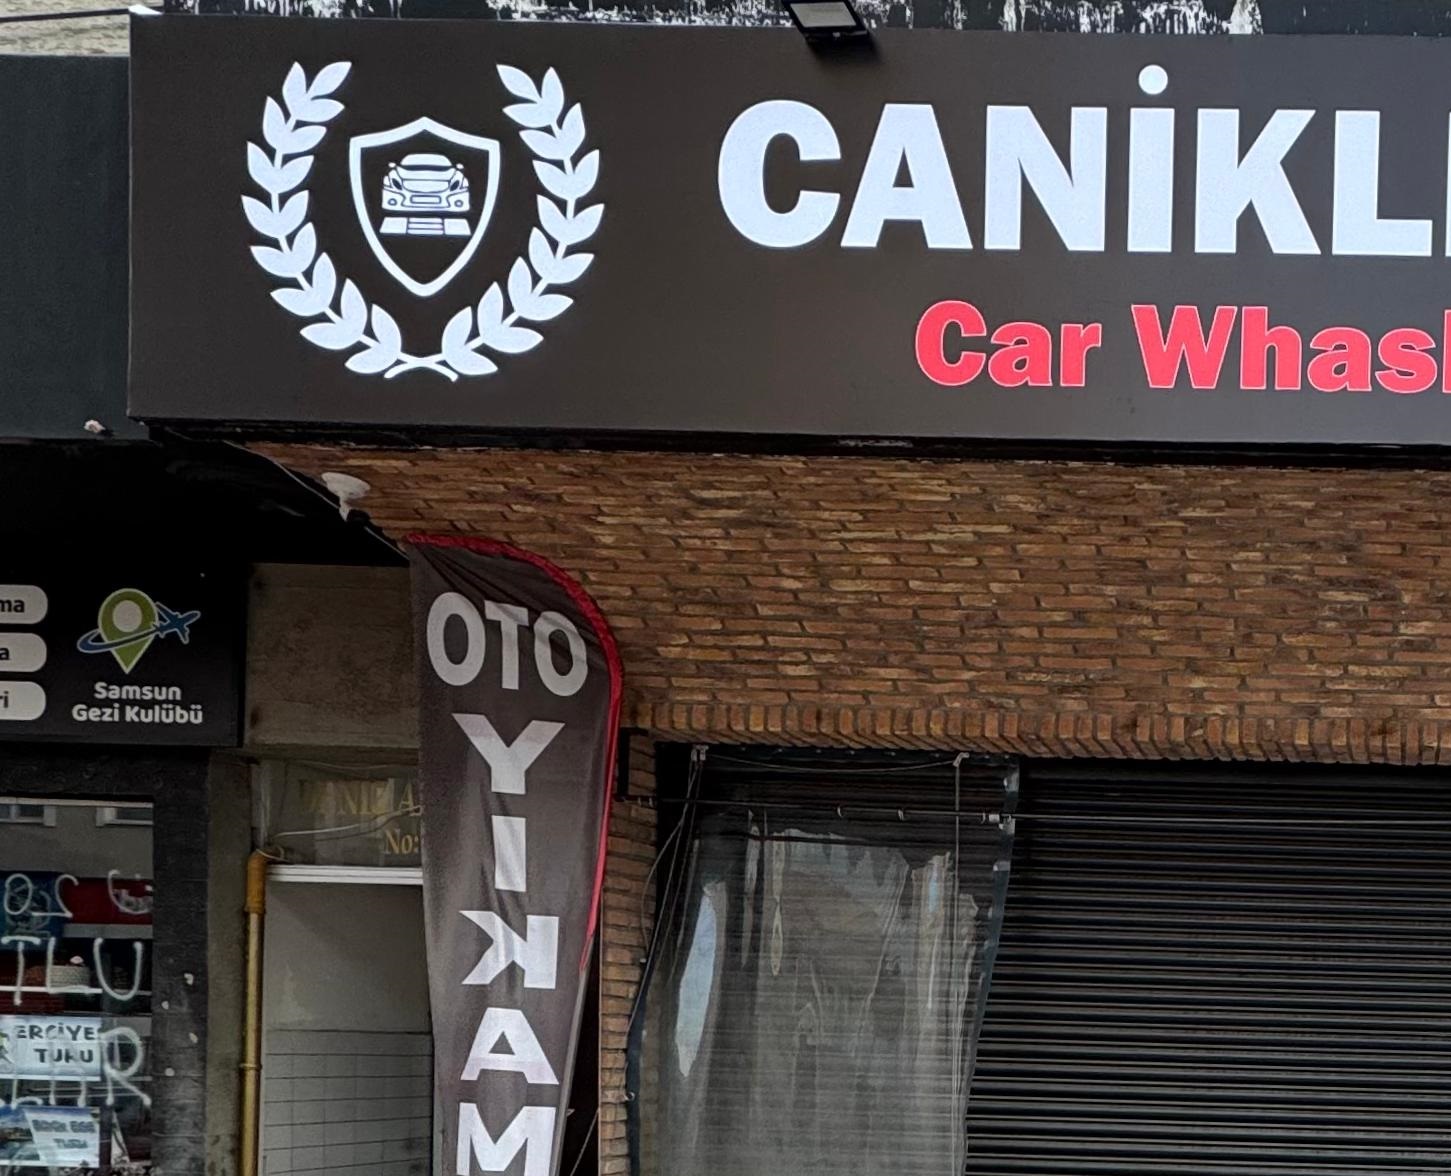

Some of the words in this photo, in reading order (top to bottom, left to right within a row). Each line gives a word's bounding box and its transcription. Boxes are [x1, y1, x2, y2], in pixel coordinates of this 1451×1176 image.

[915, 299, 1102, 388] Car
[94, 681, 182, 701] Samsun
[71, 703, 120, 722] Gezi
[125, 703, 203, 725] Kulübü
